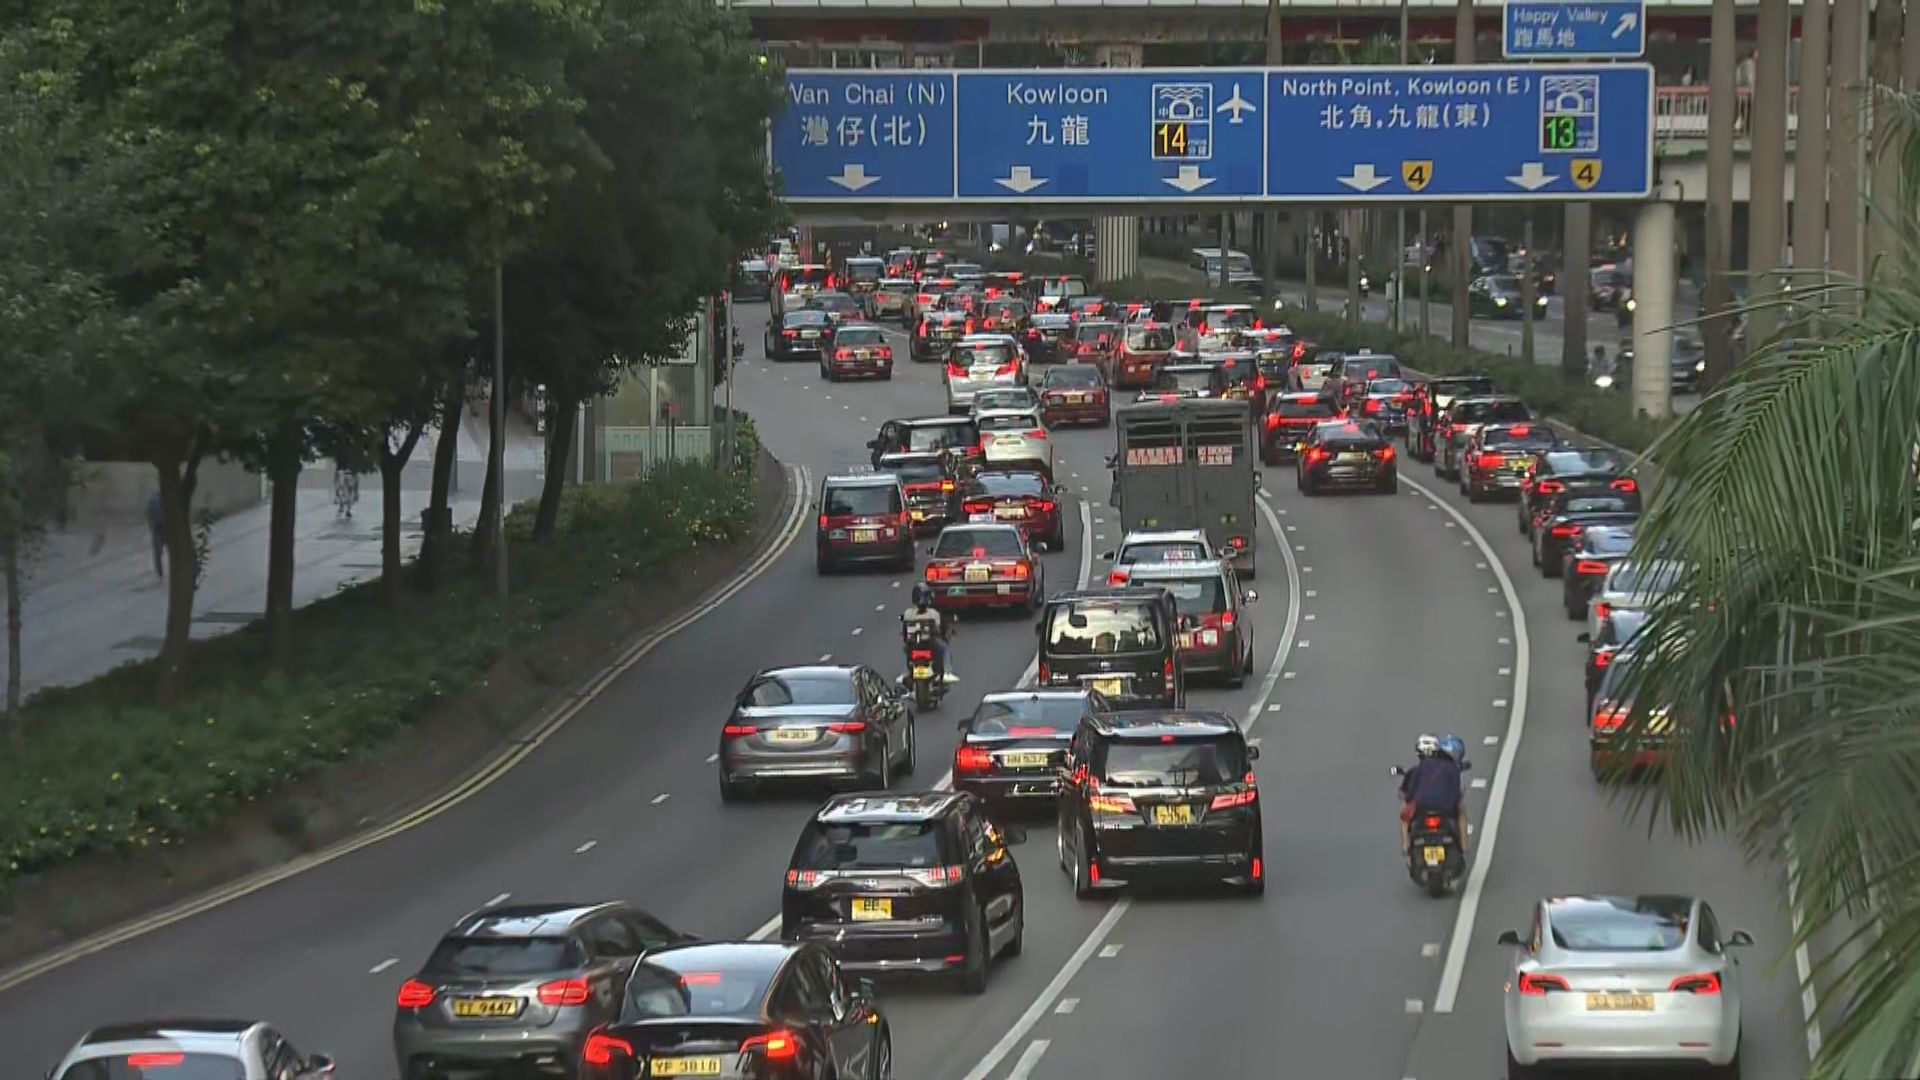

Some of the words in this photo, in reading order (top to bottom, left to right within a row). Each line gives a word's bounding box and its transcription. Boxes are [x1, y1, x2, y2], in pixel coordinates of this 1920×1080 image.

[1513, 7, 1560, 25] Happy
[1566, 7, 1608, 25] Valley
[845, 82, 895, 105] Chai
[907, 81, 946, 106] (N)
[1007, 82, 1108, 105] Kowloon
[1282, 78, 1337, 97] North
[1341, 78, 1400, 97] Point,
[1408, 77, 1491, 96] Kowloon
[1496, 76, 1531, 96] (E)
[801, 113, 927, 147] 灣仔(北)
[1026, 114, 1090, 146] 九龍
[1158, 123, 1186, 155] 14
[1545, 117, 1575, 149] 13
[1407, 165, 1425, 185] 4
[1577, 164, 1594, 183] 4
